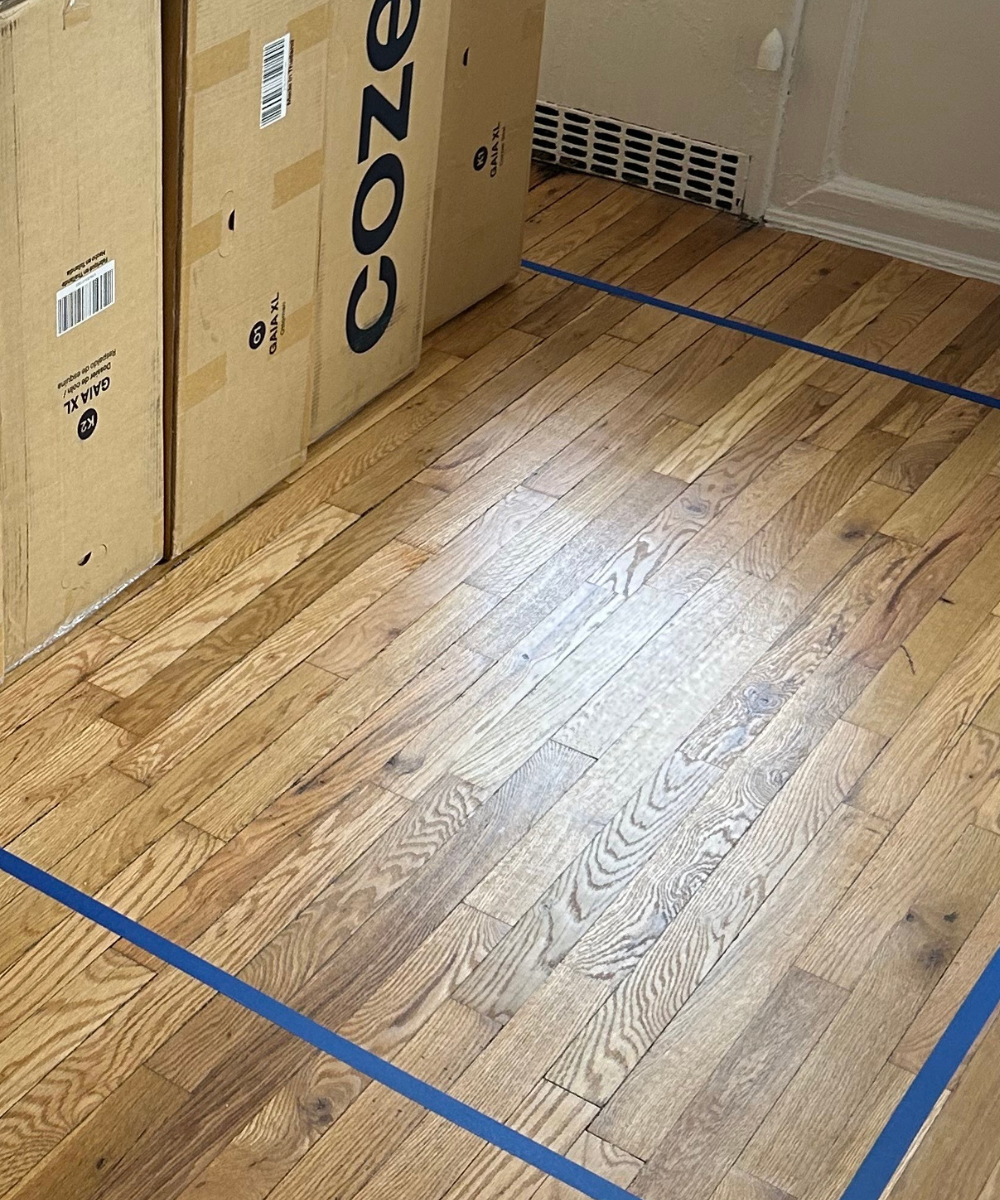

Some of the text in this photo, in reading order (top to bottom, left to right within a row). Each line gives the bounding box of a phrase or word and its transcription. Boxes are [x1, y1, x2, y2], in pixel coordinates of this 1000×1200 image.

[490, 121, 500, 177] GAIA XL
[269, 292, 279, 355] GAIA XL
[82, 365, 90, 374] de
[82, 376, 89, 385] de
[64, 377, 110, 414] GAIA XL
